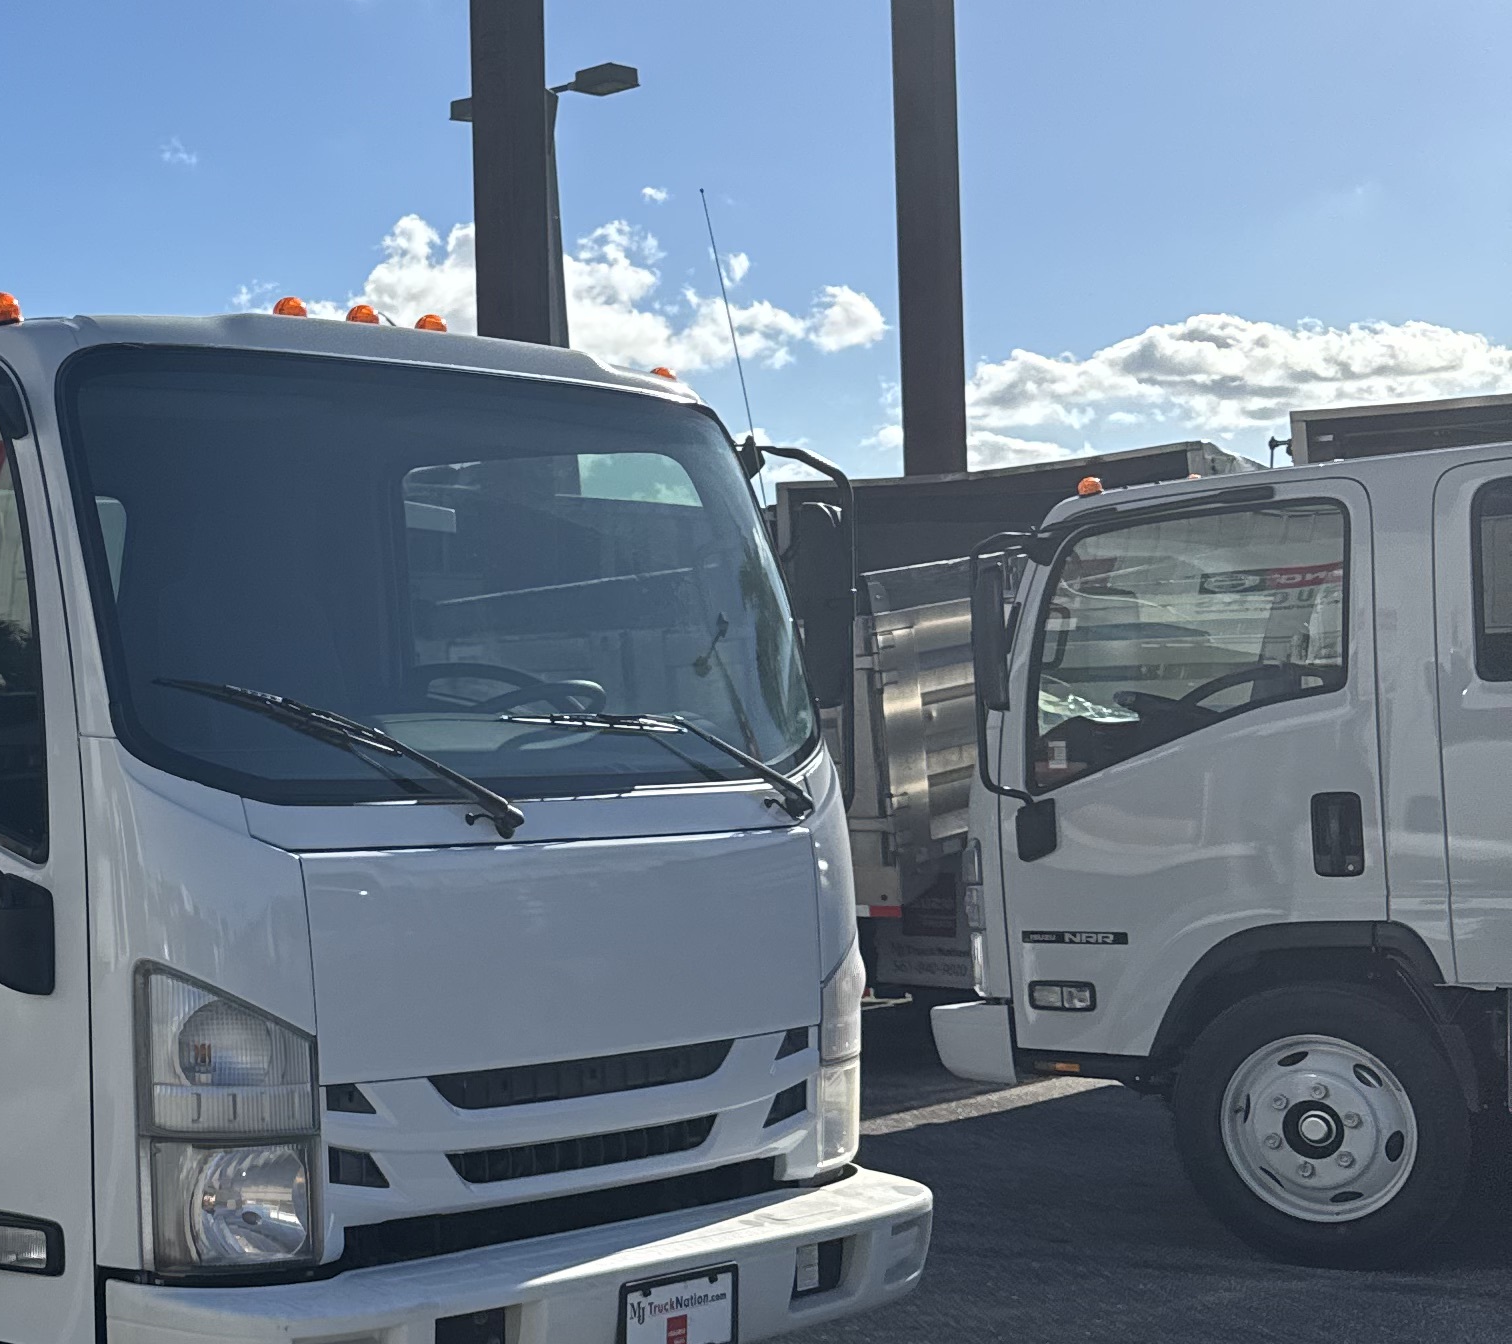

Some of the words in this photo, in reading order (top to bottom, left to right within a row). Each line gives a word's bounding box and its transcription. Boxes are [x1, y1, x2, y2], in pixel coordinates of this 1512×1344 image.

[1063, 932, 1114, 944] NRR
[629, 1300, 646, 1325] MJ
[648, 1291, 727, 1315] TruckNation.com
